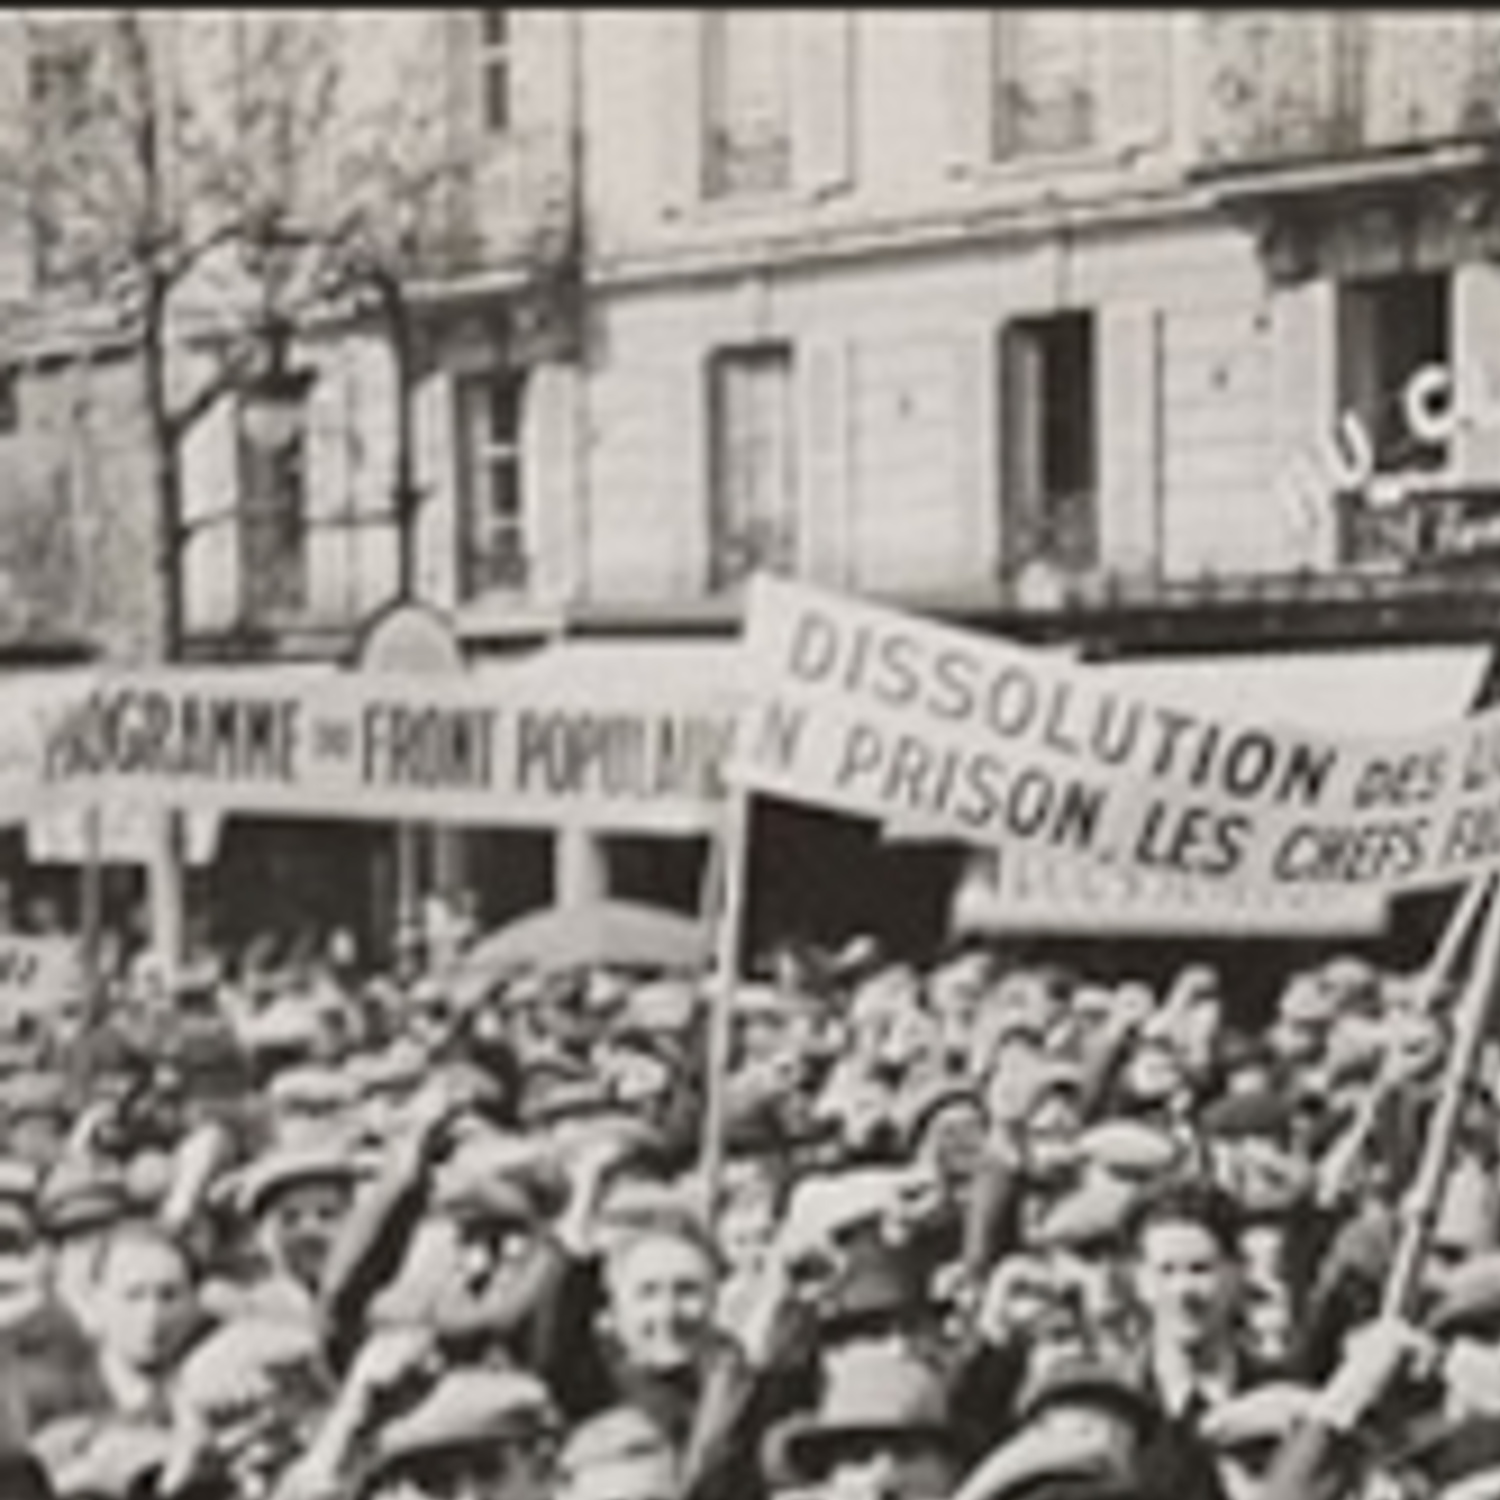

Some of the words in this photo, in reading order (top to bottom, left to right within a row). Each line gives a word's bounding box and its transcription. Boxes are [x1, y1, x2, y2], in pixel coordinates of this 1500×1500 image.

[362, 703, 498, 790] FRONT
[788, 608, 1340, 808] DISSOLUTION
[1353, 746, 1450, 810] DES
[1134, 798, 1252, 878] LES
[1270, 814, 1434, 884] CHEFS
